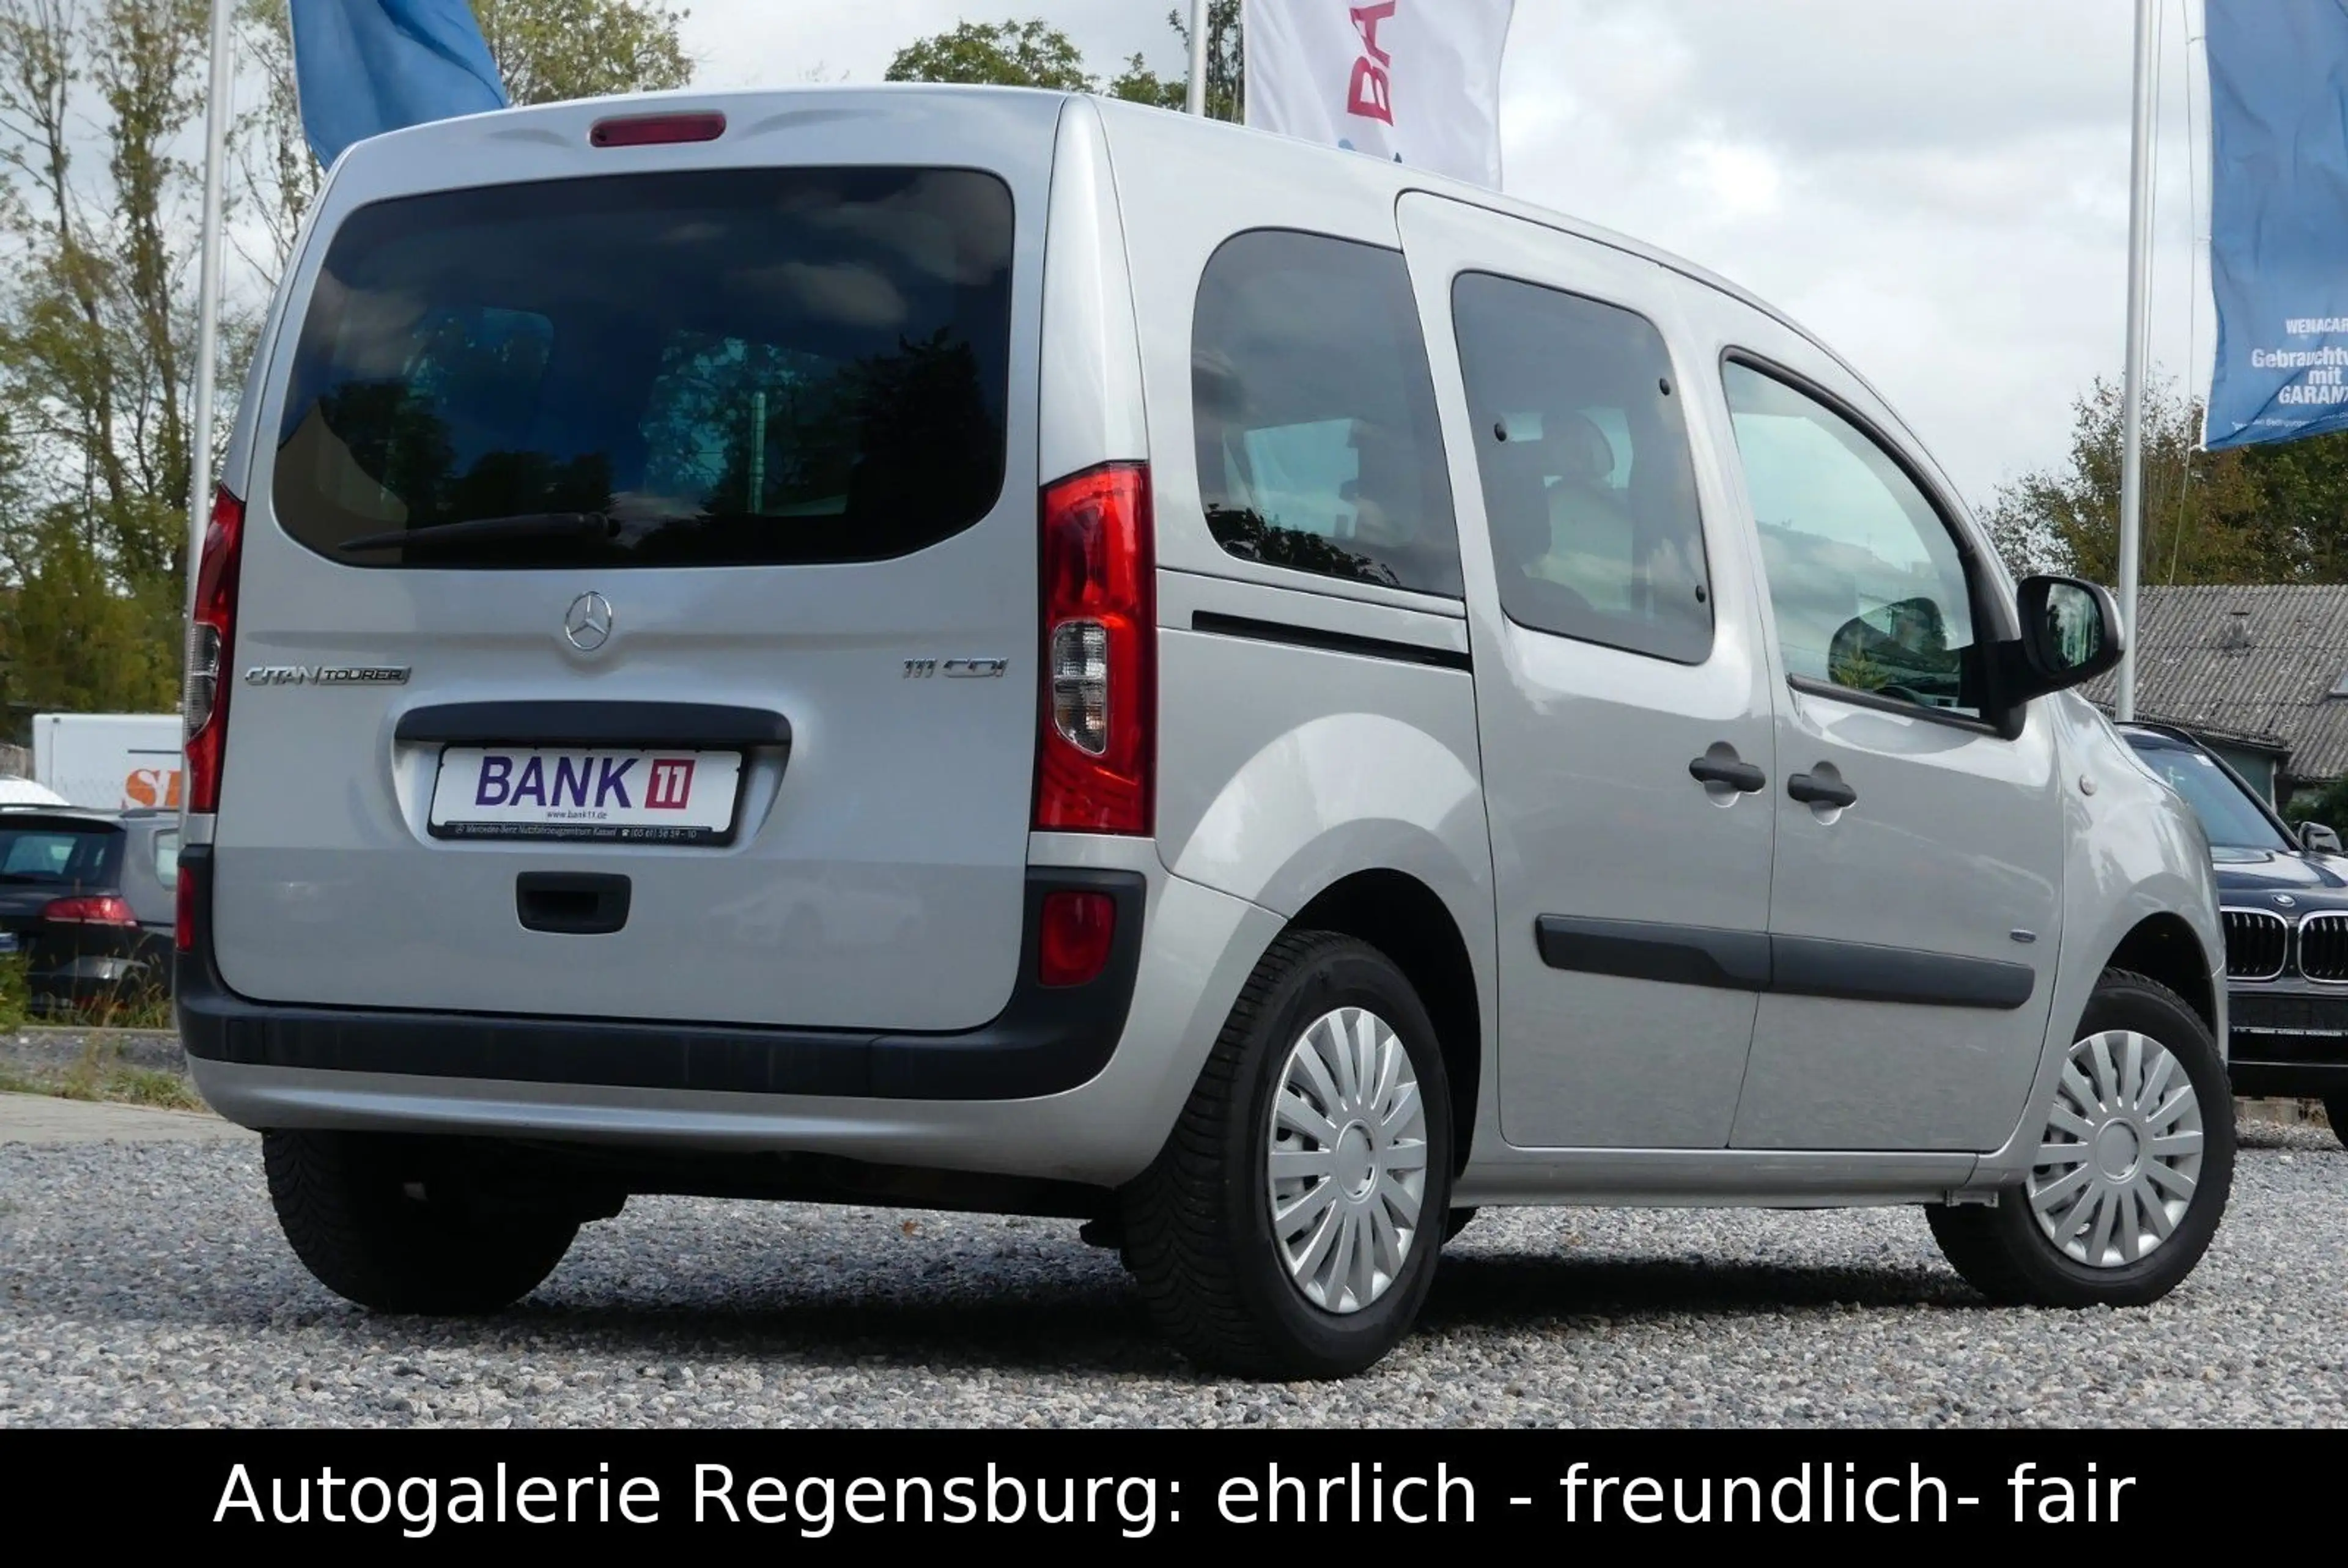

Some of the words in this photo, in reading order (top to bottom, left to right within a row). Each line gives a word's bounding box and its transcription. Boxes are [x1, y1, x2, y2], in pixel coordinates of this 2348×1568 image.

[2308, 366, 2342, 385] mit
[245, 666, 322, 685] CITAN
[323, 669, 405, 683] TOURER
[942, 657, 1009, 679] CDI
[475, 756, 640, 809] BANK
[654, 764, 690, 805] 11
[547, 809, 608, 820] www.bank11.de
